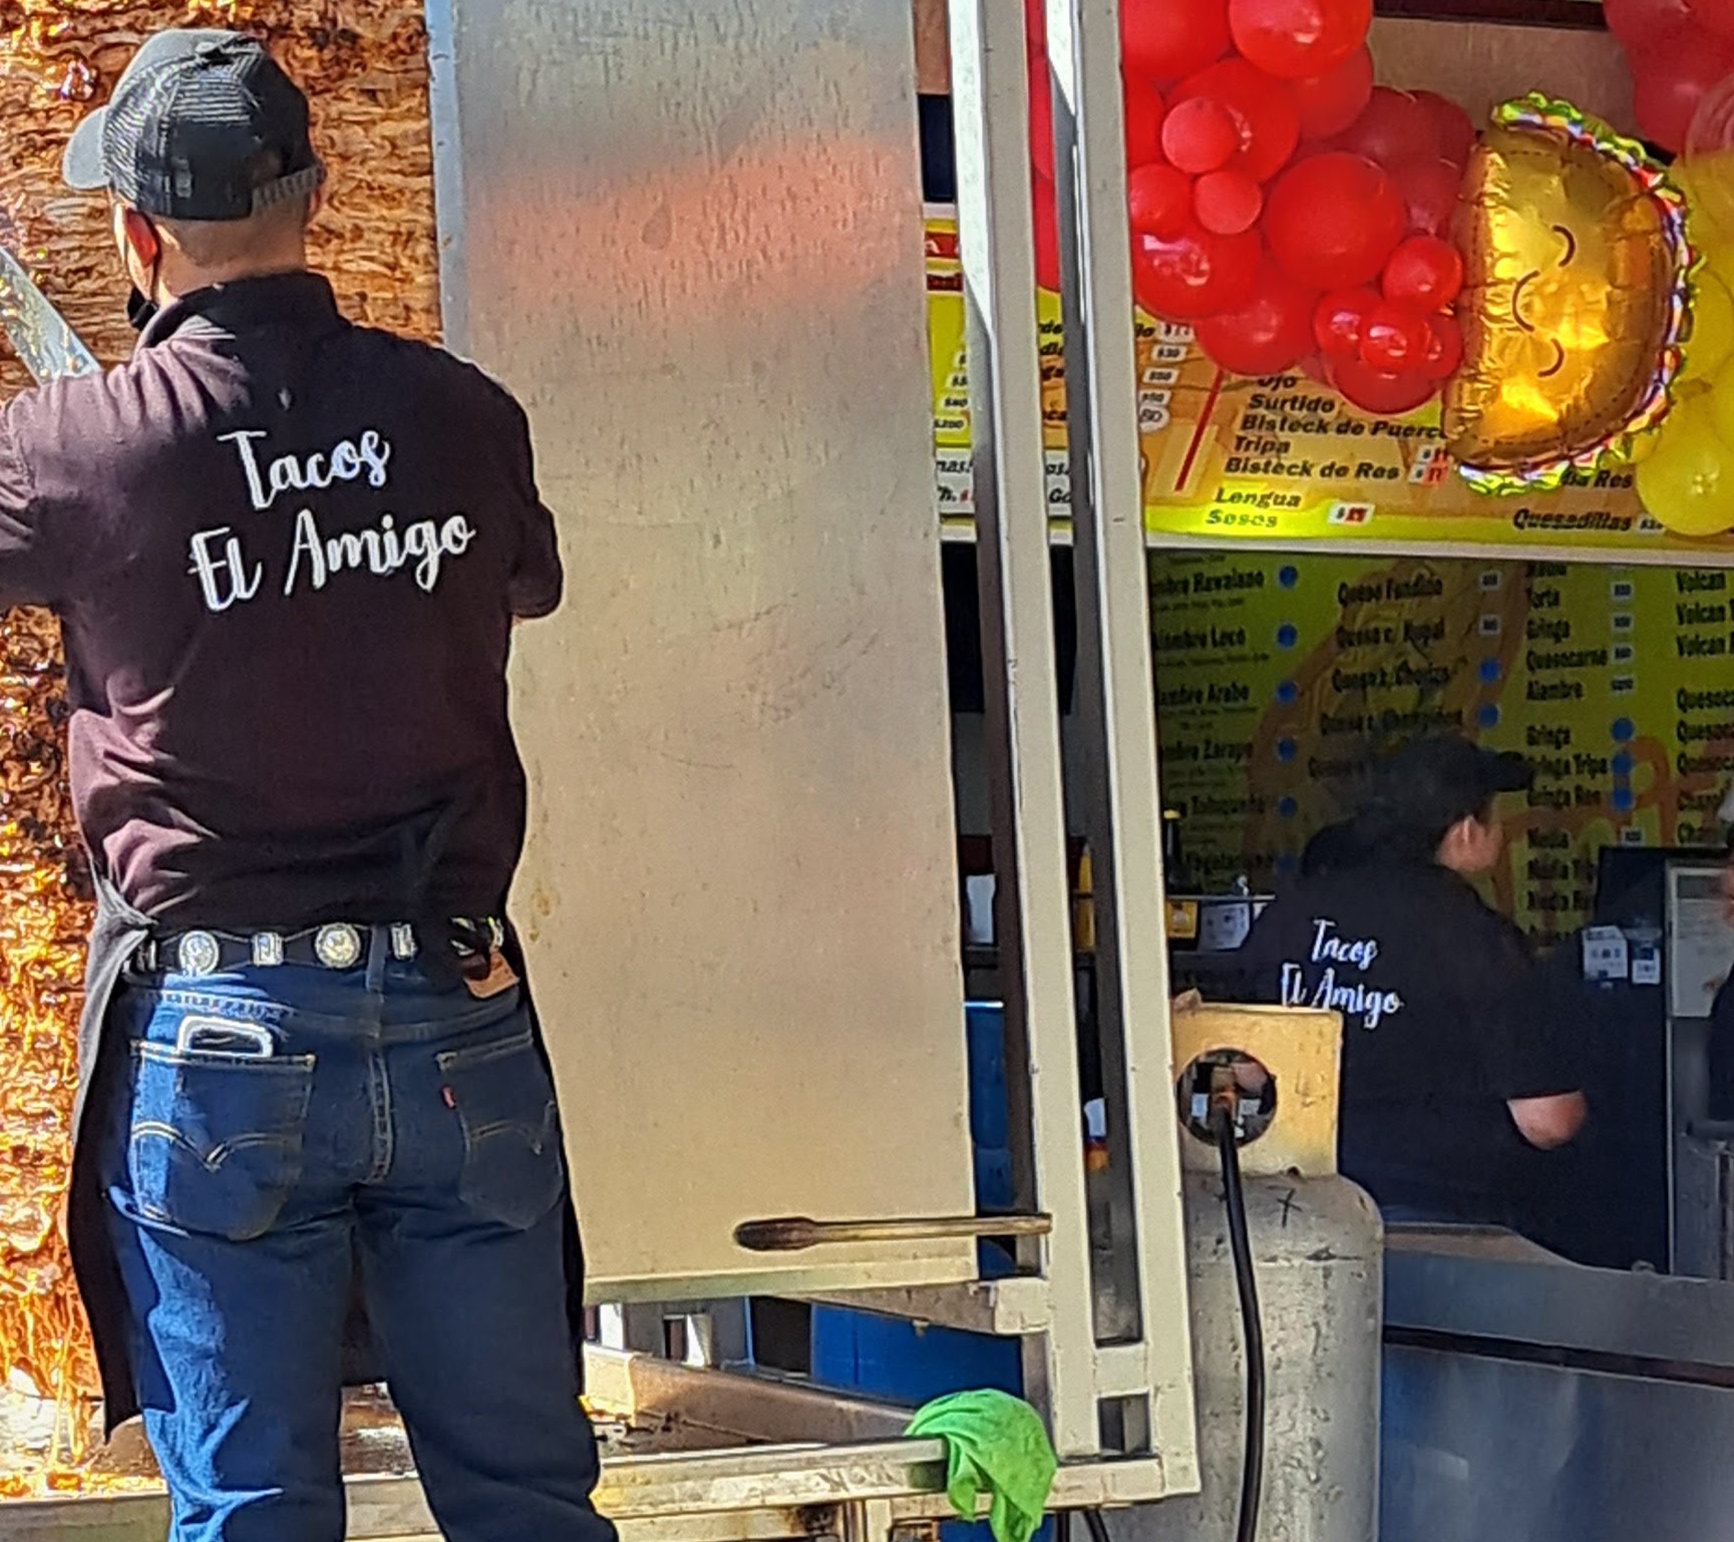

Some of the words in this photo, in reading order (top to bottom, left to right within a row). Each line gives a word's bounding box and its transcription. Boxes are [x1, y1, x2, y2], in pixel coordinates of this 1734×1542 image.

[1248, 393, 1335, 414] Surtido
[1240, 414, 1329, 435] Bisteck
[1335, 417, 1364, 436] de
[1233, 435, 1291, 455] Tripa
[216, 429, 392, 510] Tacos
[1223, 455, 1314, 476] Bisteck
[1319, 461, 1350, 478] de
[1354, 462, 1400, 481] Res
[1214, 486, 1302, 509] Lengua
[1512, 508, 1633, 532] Quesadillas
[187, 526, 263, 612] El
[283, 508, 477, 596] Amigo
[1310, 918, 1380, 971] Tacos
[1309, 966, 1406, 1030] Amigo
